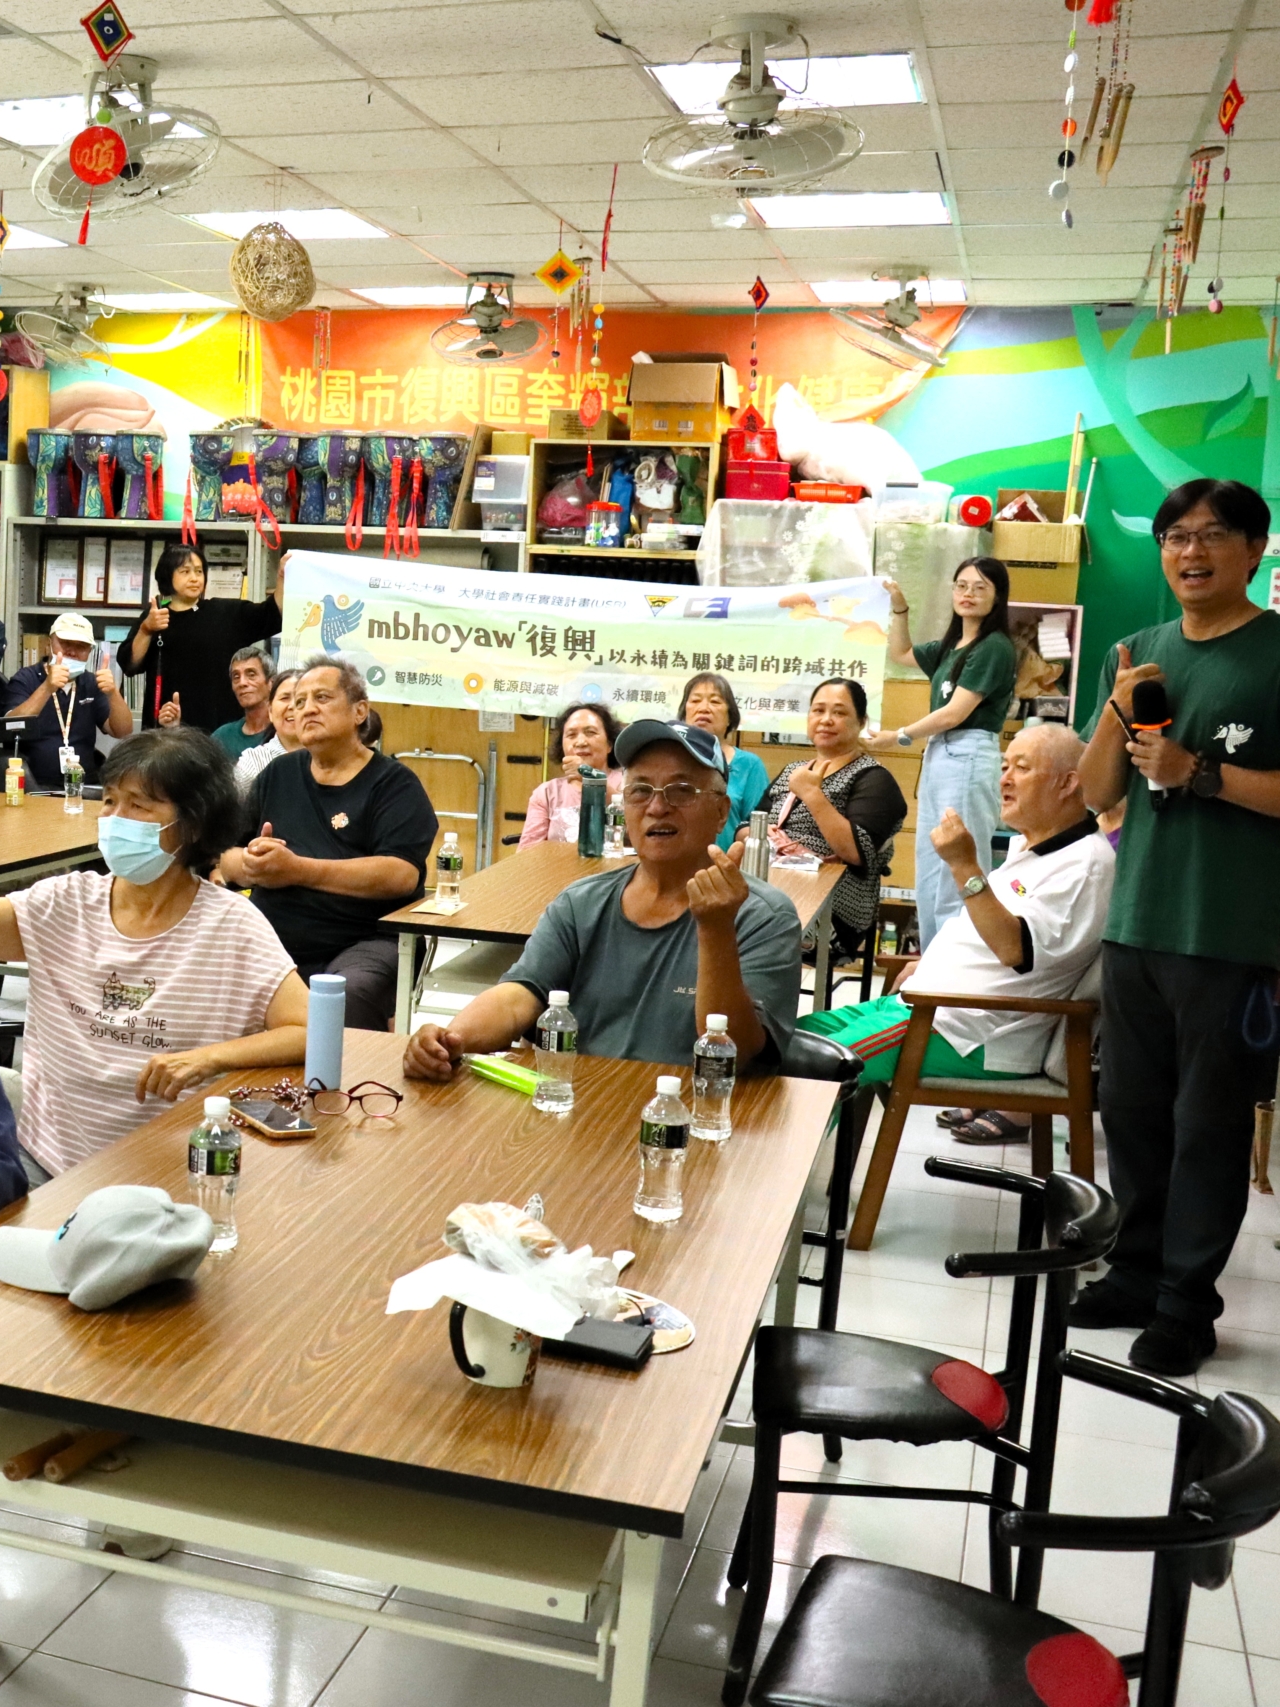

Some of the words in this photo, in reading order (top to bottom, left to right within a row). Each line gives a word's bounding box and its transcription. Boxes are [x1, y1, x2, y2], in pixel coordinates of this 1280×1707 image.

[367, 611, 515, 653] mbhoyaw
[394, 671, 443, 687] 智慧防災
[493, 678, 560, 697] 能源與減碳
[612, 687, 667, 705] 永續環境
[68, 1000, 86, 1015] YOU
[95, 1010, 116, 1024] ARE
[145, 1016, 167, 1031] THE
